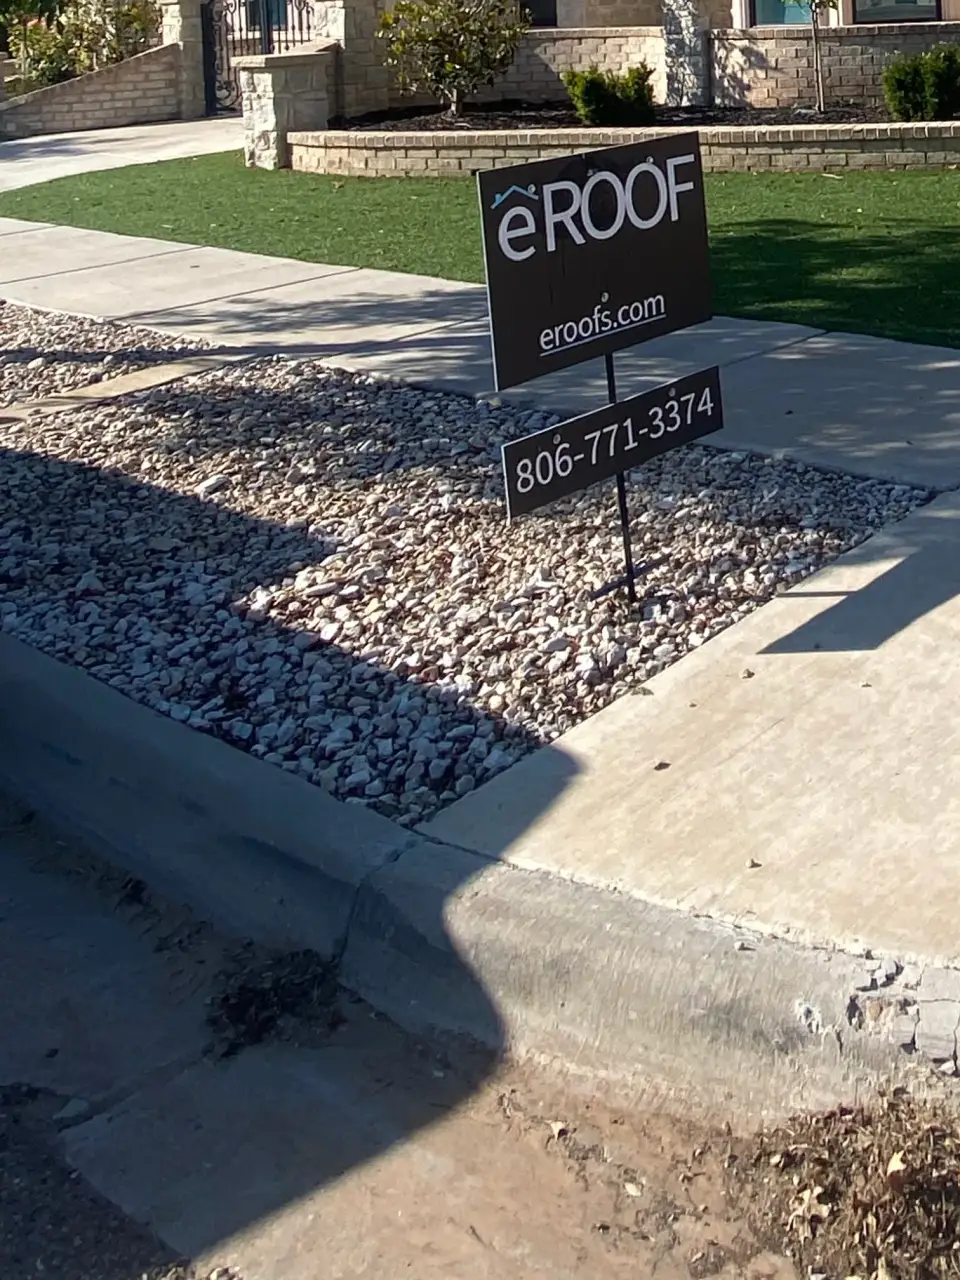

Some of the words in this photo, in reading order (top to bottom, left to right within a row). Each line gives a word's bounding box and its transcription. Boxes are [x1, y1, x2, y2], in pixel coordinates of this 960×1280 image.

[498, 154, 695, 262] eROOF
[539, 293, 666, 353] eroofs.com
[516, 388, 715, 494] 806-771-3374
